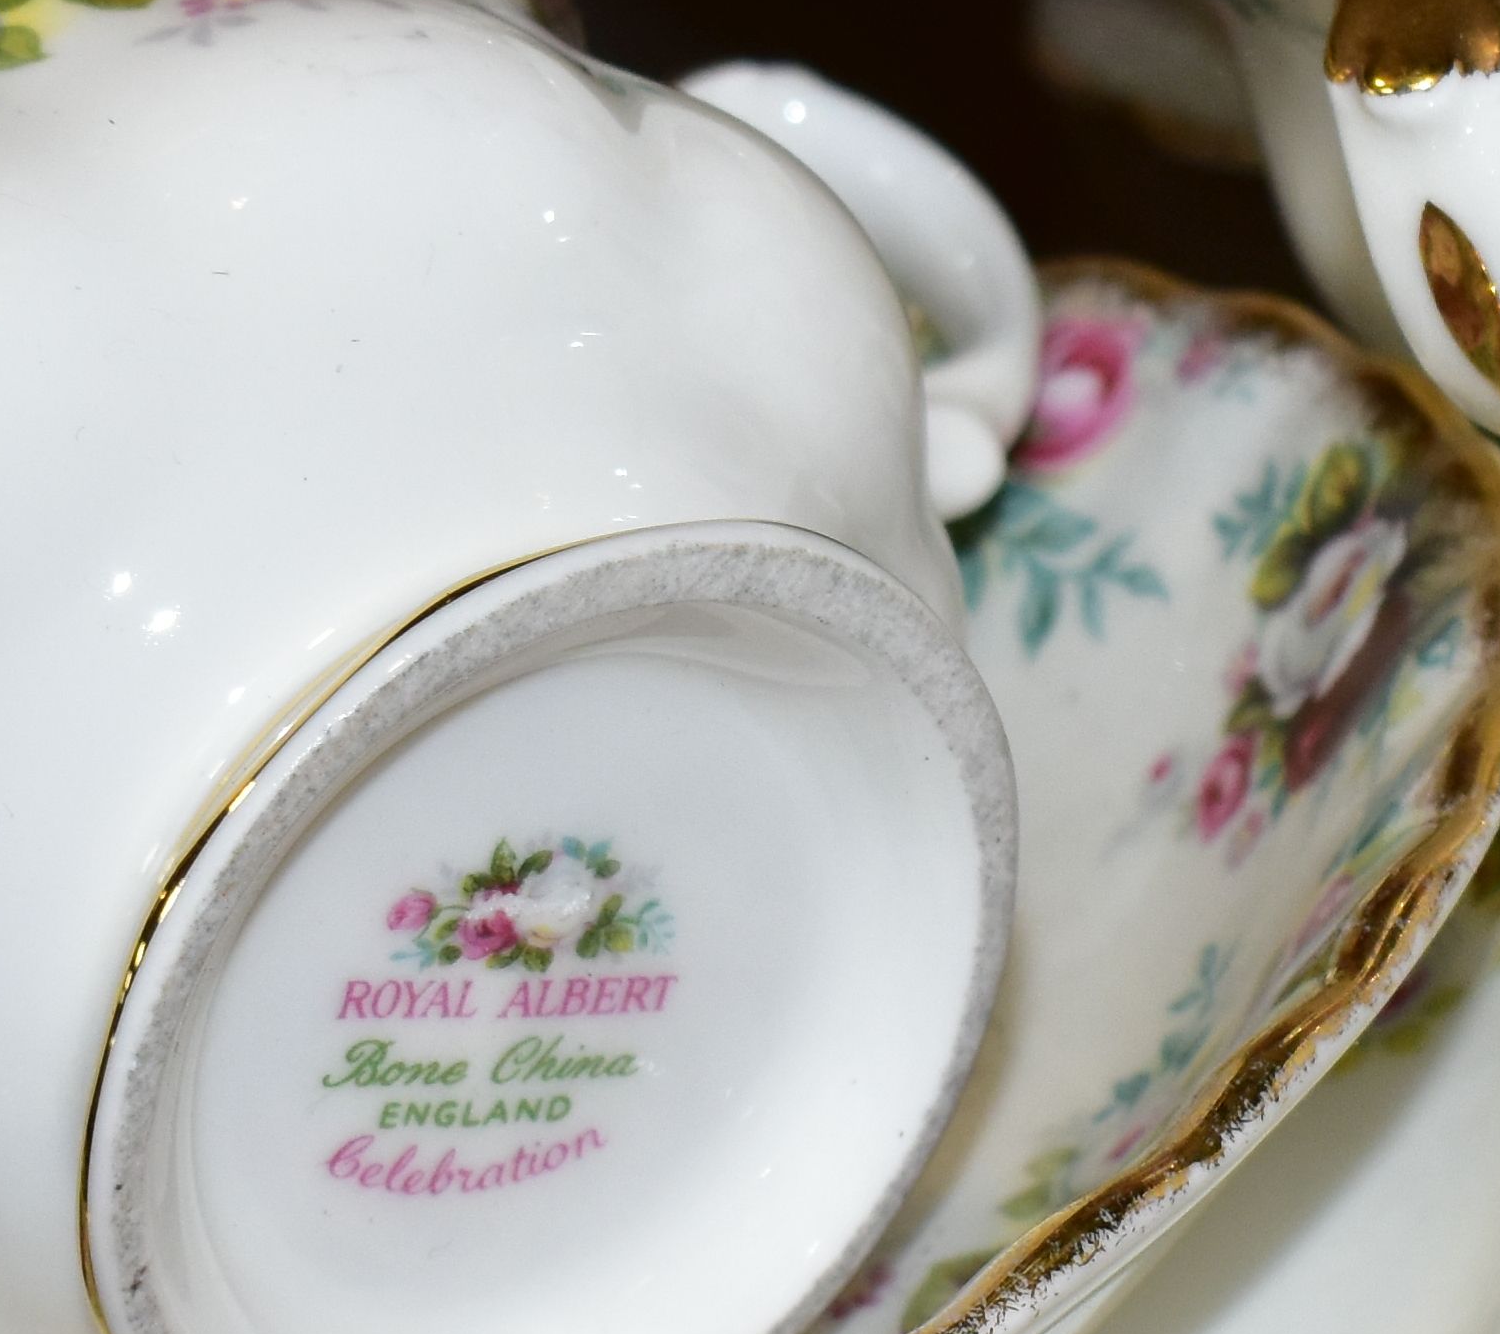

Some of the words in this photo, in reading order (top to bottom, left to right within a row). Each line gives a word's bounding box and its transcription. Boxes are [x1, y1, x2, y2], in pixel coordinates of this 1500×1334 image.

[336, 977, 477, 1020] ROYAL
[497, 973, 679, 1019] ALBERT
[322, 1038, 468, 1088] Bone
[490, 1034, 640, 1085] China
[378, 1094, 573, 1129] ENGLAND
[326, 1127, 607, 1196] Celebration
